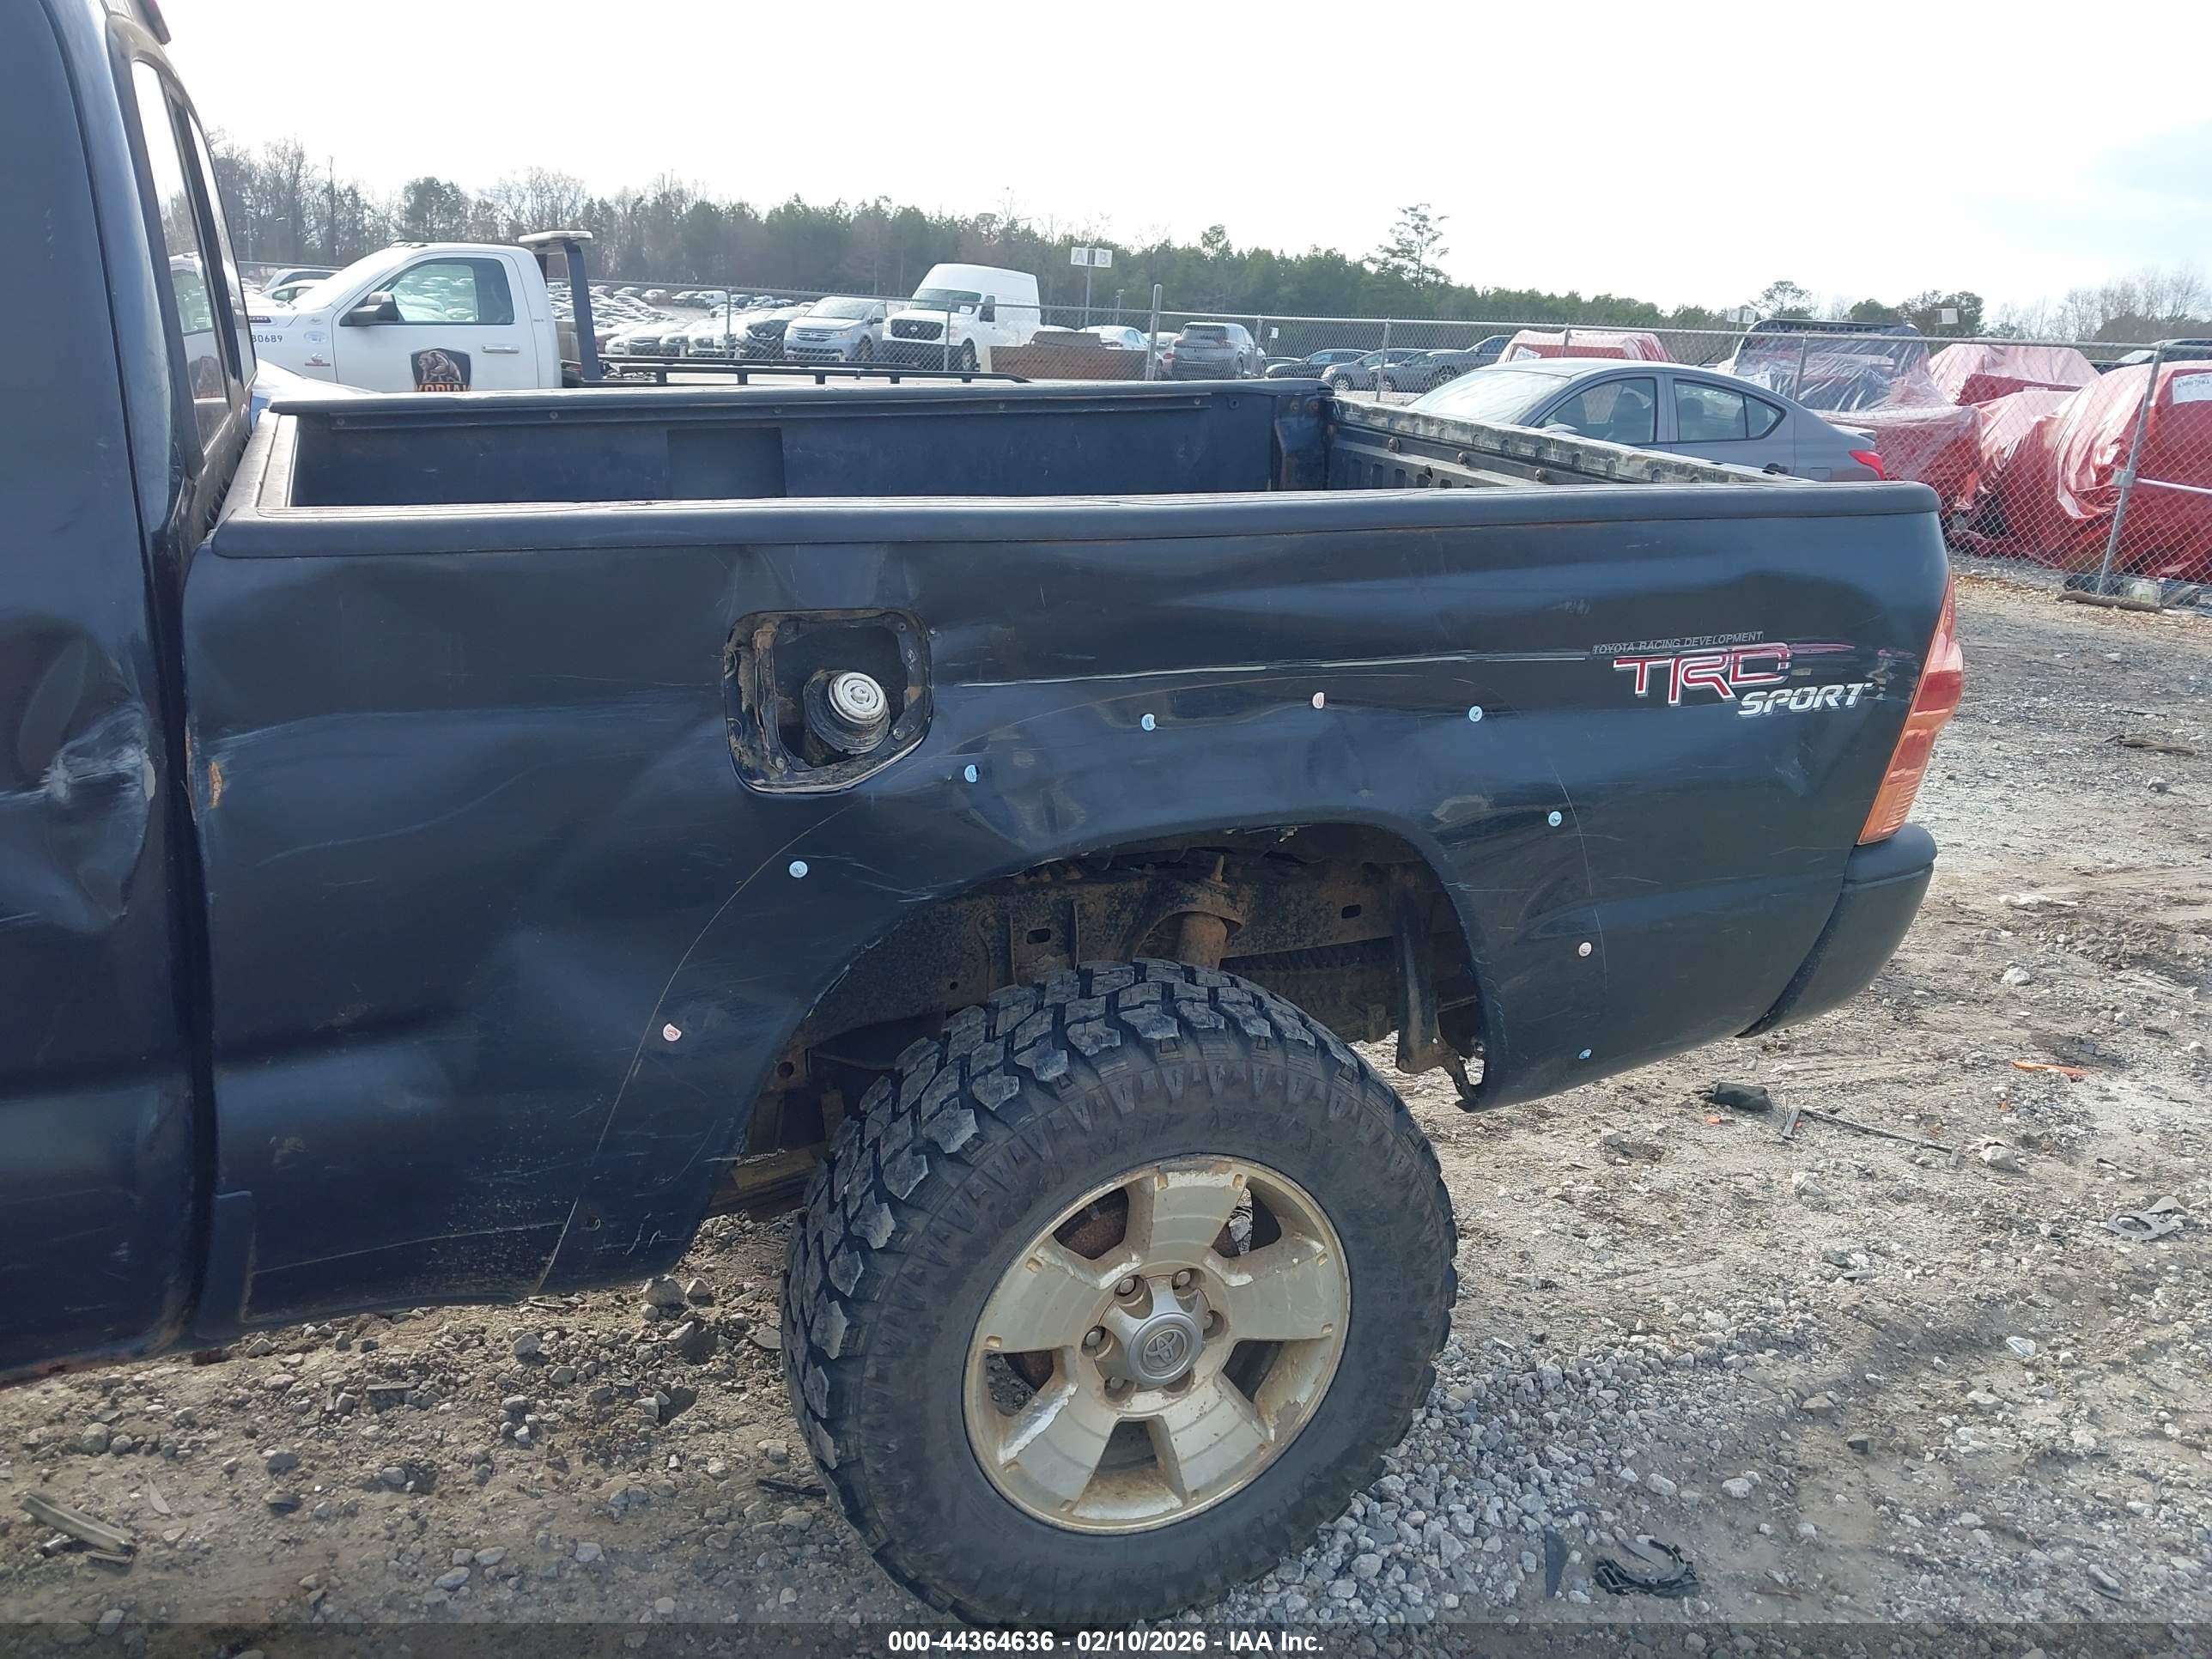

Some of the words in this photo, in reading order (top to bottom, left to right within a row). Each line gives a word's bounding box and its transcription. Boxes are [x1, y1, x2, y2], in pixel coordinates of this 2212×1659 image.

[1592, 641, 1635, 655] TOYOTA
[1638, 638, 1681, 651] RACING
[1683, 630, 1764, 647] DEVELOPMENT
[1613, 642, 1791, 708] TRD
[1737, 683, 1874, 718] SPORT
